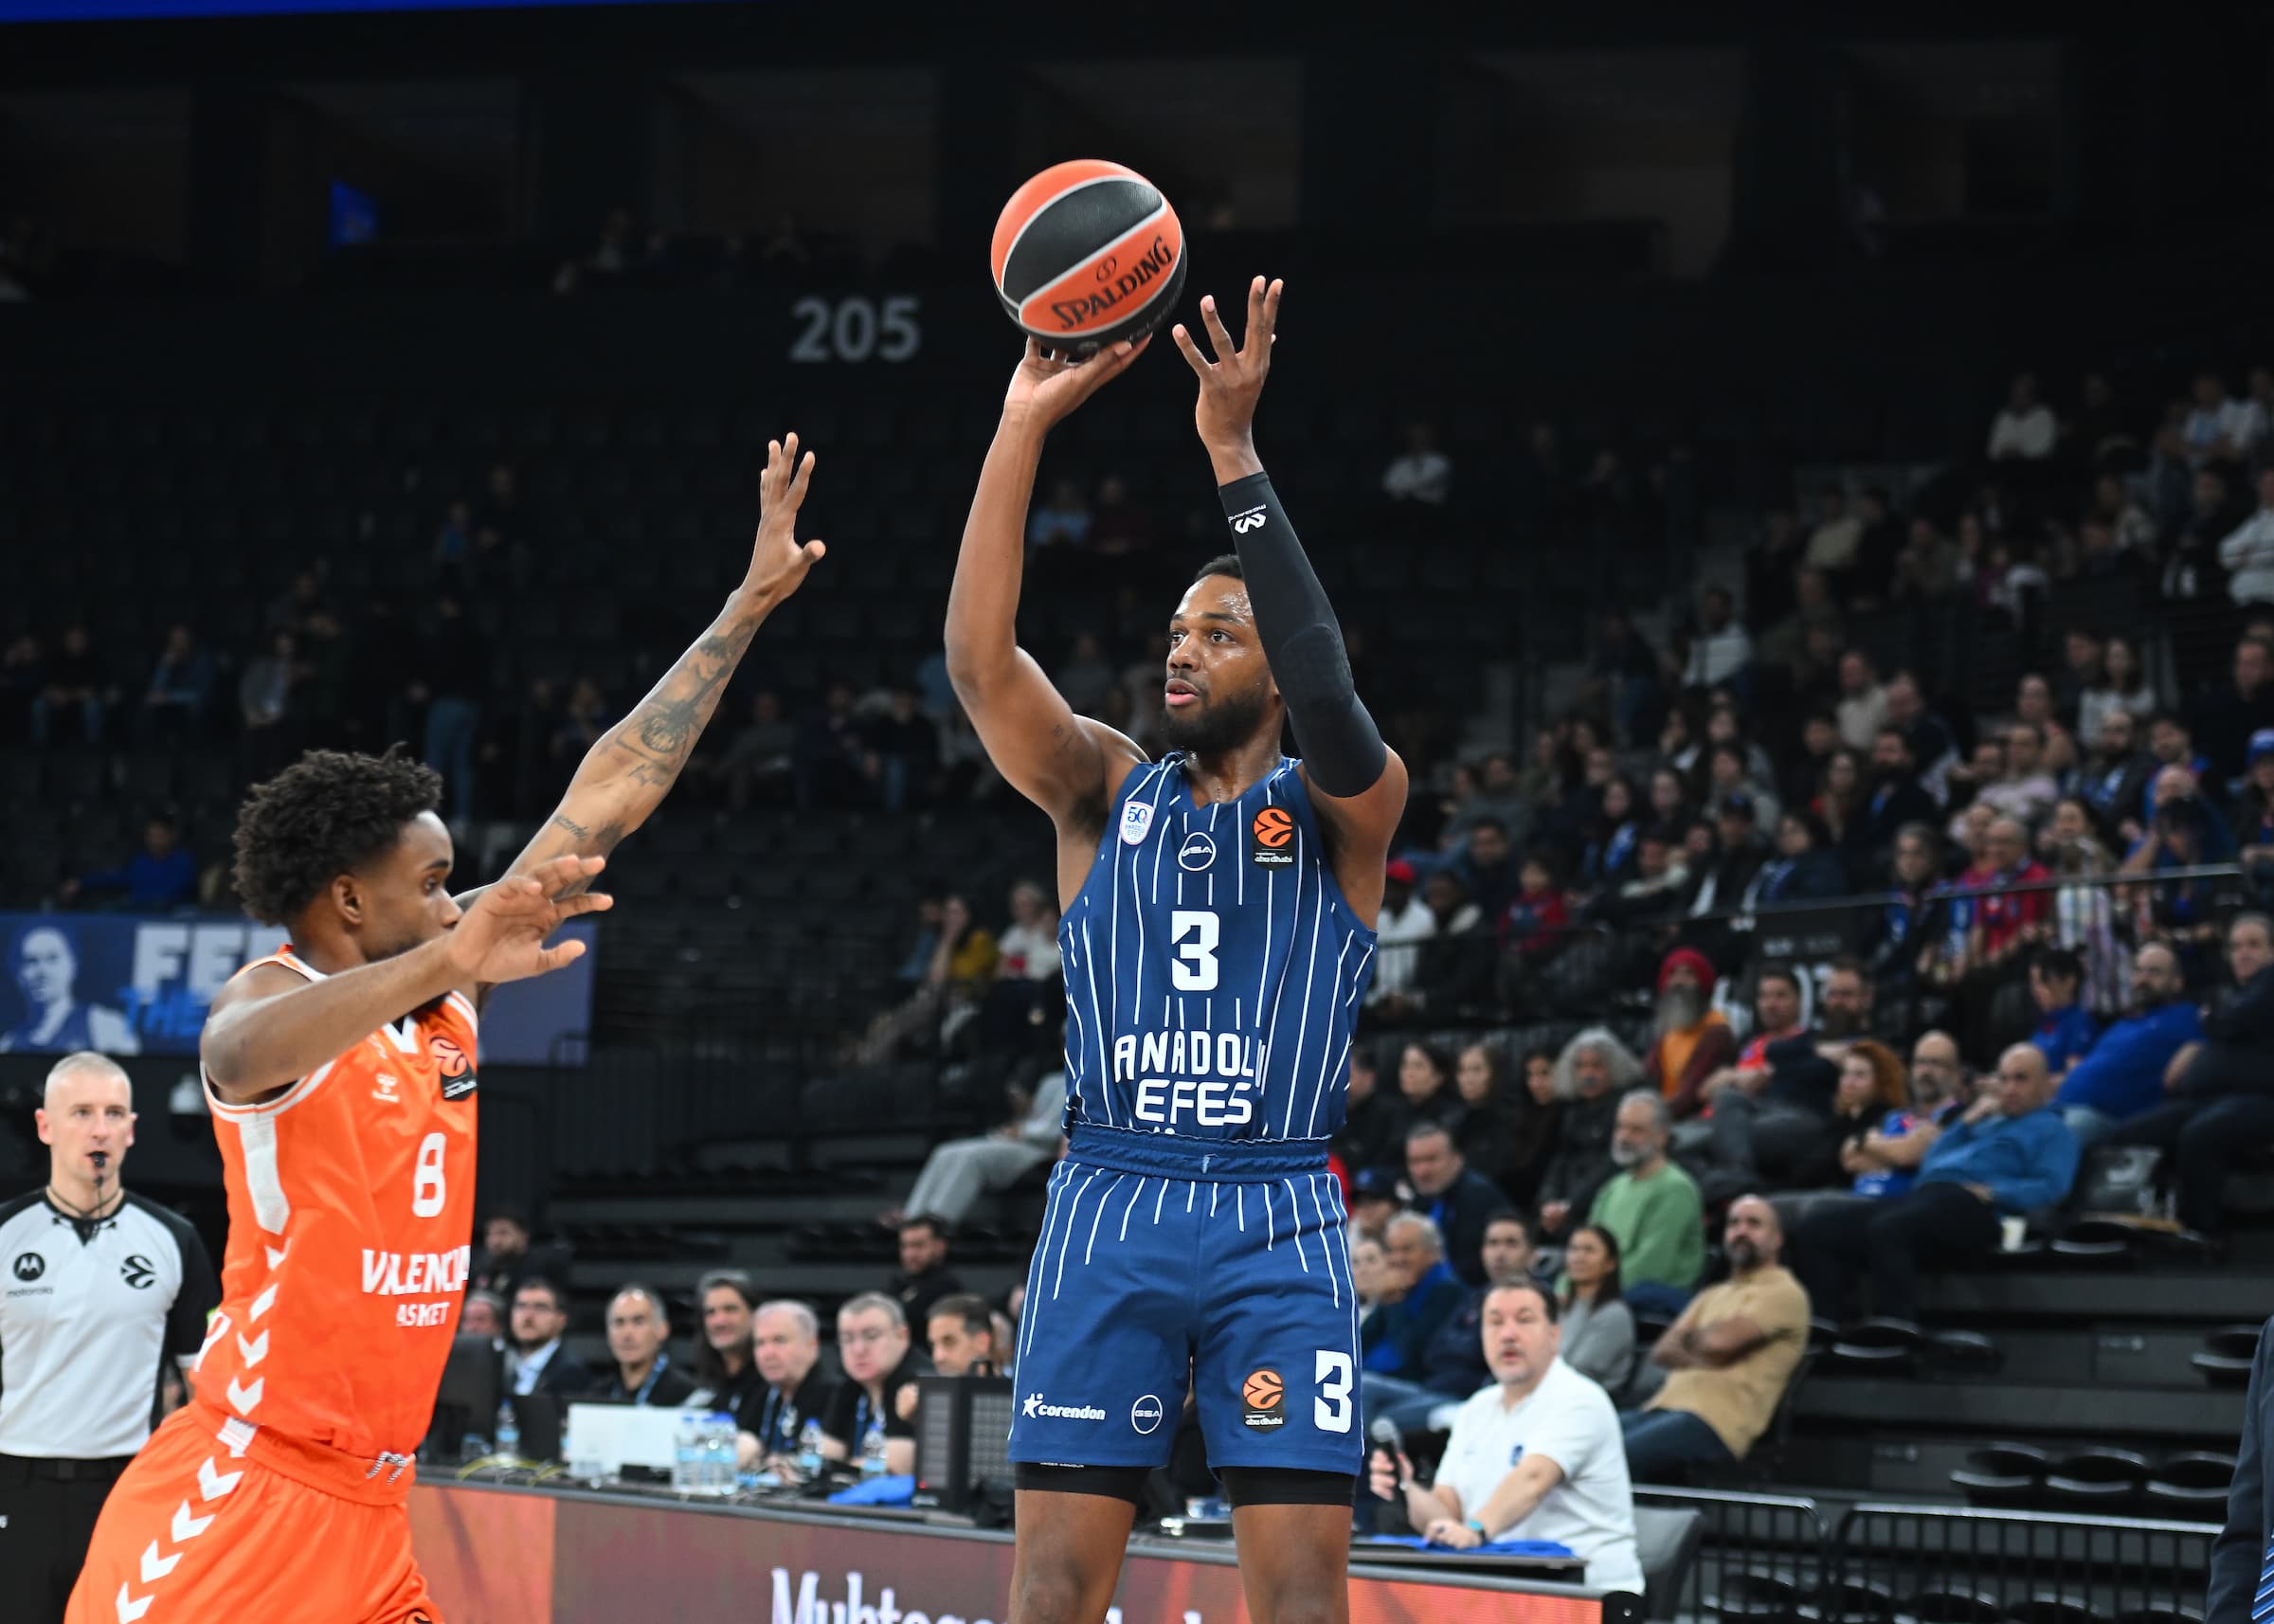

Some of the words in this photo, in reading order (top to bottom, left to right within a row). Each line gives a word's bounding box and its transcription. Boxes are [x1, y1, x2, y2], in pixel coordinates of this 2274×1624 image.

[1051, 235, 1173, 330] SPALDING
[789, 297, 920, 362] 205
[1128, 806, 1146, 823] 50
[1172, 911, 1220, 991] 3
[1135, 1079, 1253, 1127] EFES
[412, 1133, 446, 1218] 8
[1038, 1405, 1106, 1420] corendon
[1135, 1409, 1161, 1417] GSA
[1314, 1350, 1353, 1434] 3
